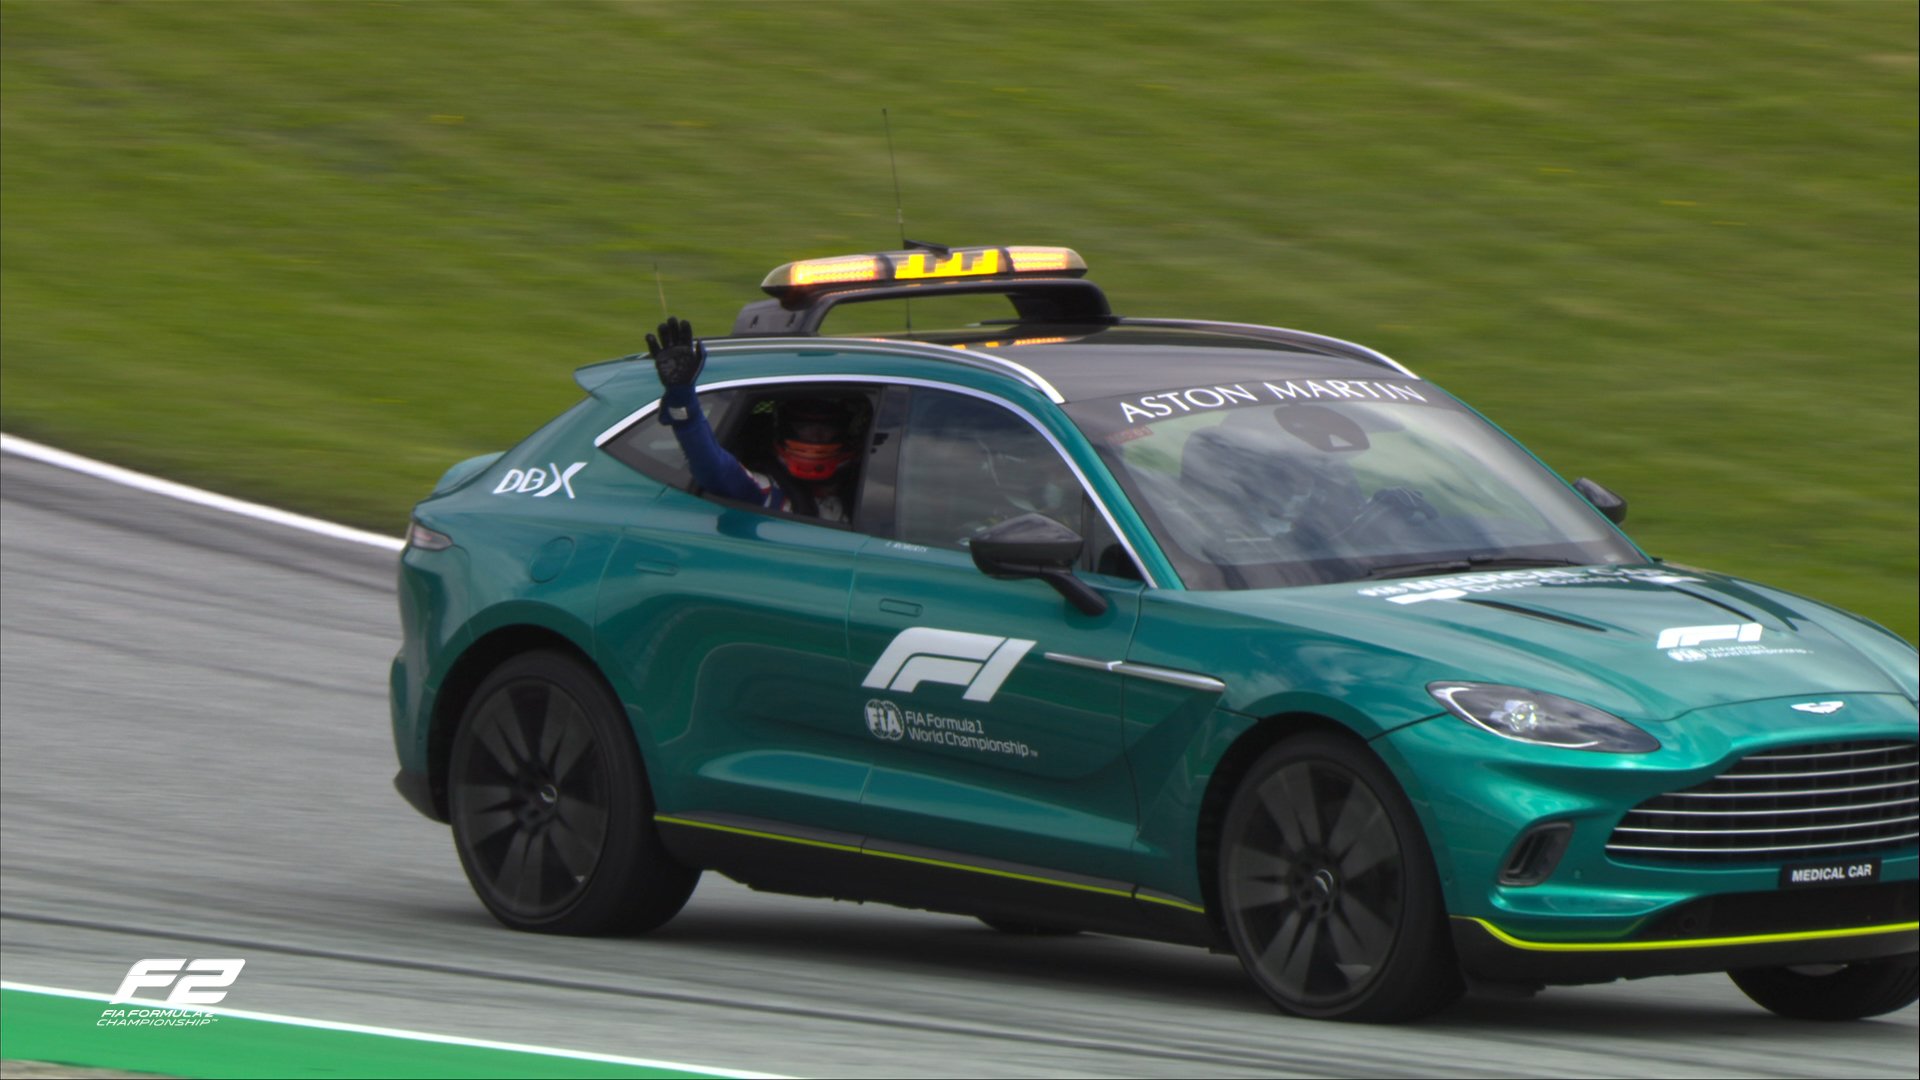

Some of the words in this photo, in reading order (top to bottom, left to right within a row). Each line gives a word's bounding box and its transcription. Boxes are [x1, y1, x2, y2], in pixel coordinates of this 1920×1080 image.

[1119, 383, 1259, 424] ASTON
[1263, 379, 1428, 402] MARTIN
[492, 462, 588, 499] DBX
[861, 626, 1037, 703] F1
[867, 706, 900, 733] FIA
[905, 710, 925, 726] FIA
[926, 713, 976, 732] Formula
[977, 719, 984, 735] 1
[907, 727, 944, 745] World
[1791, 866, 1846, 883] MEDICAL
[1847, 863, 1873, 879] CAR
